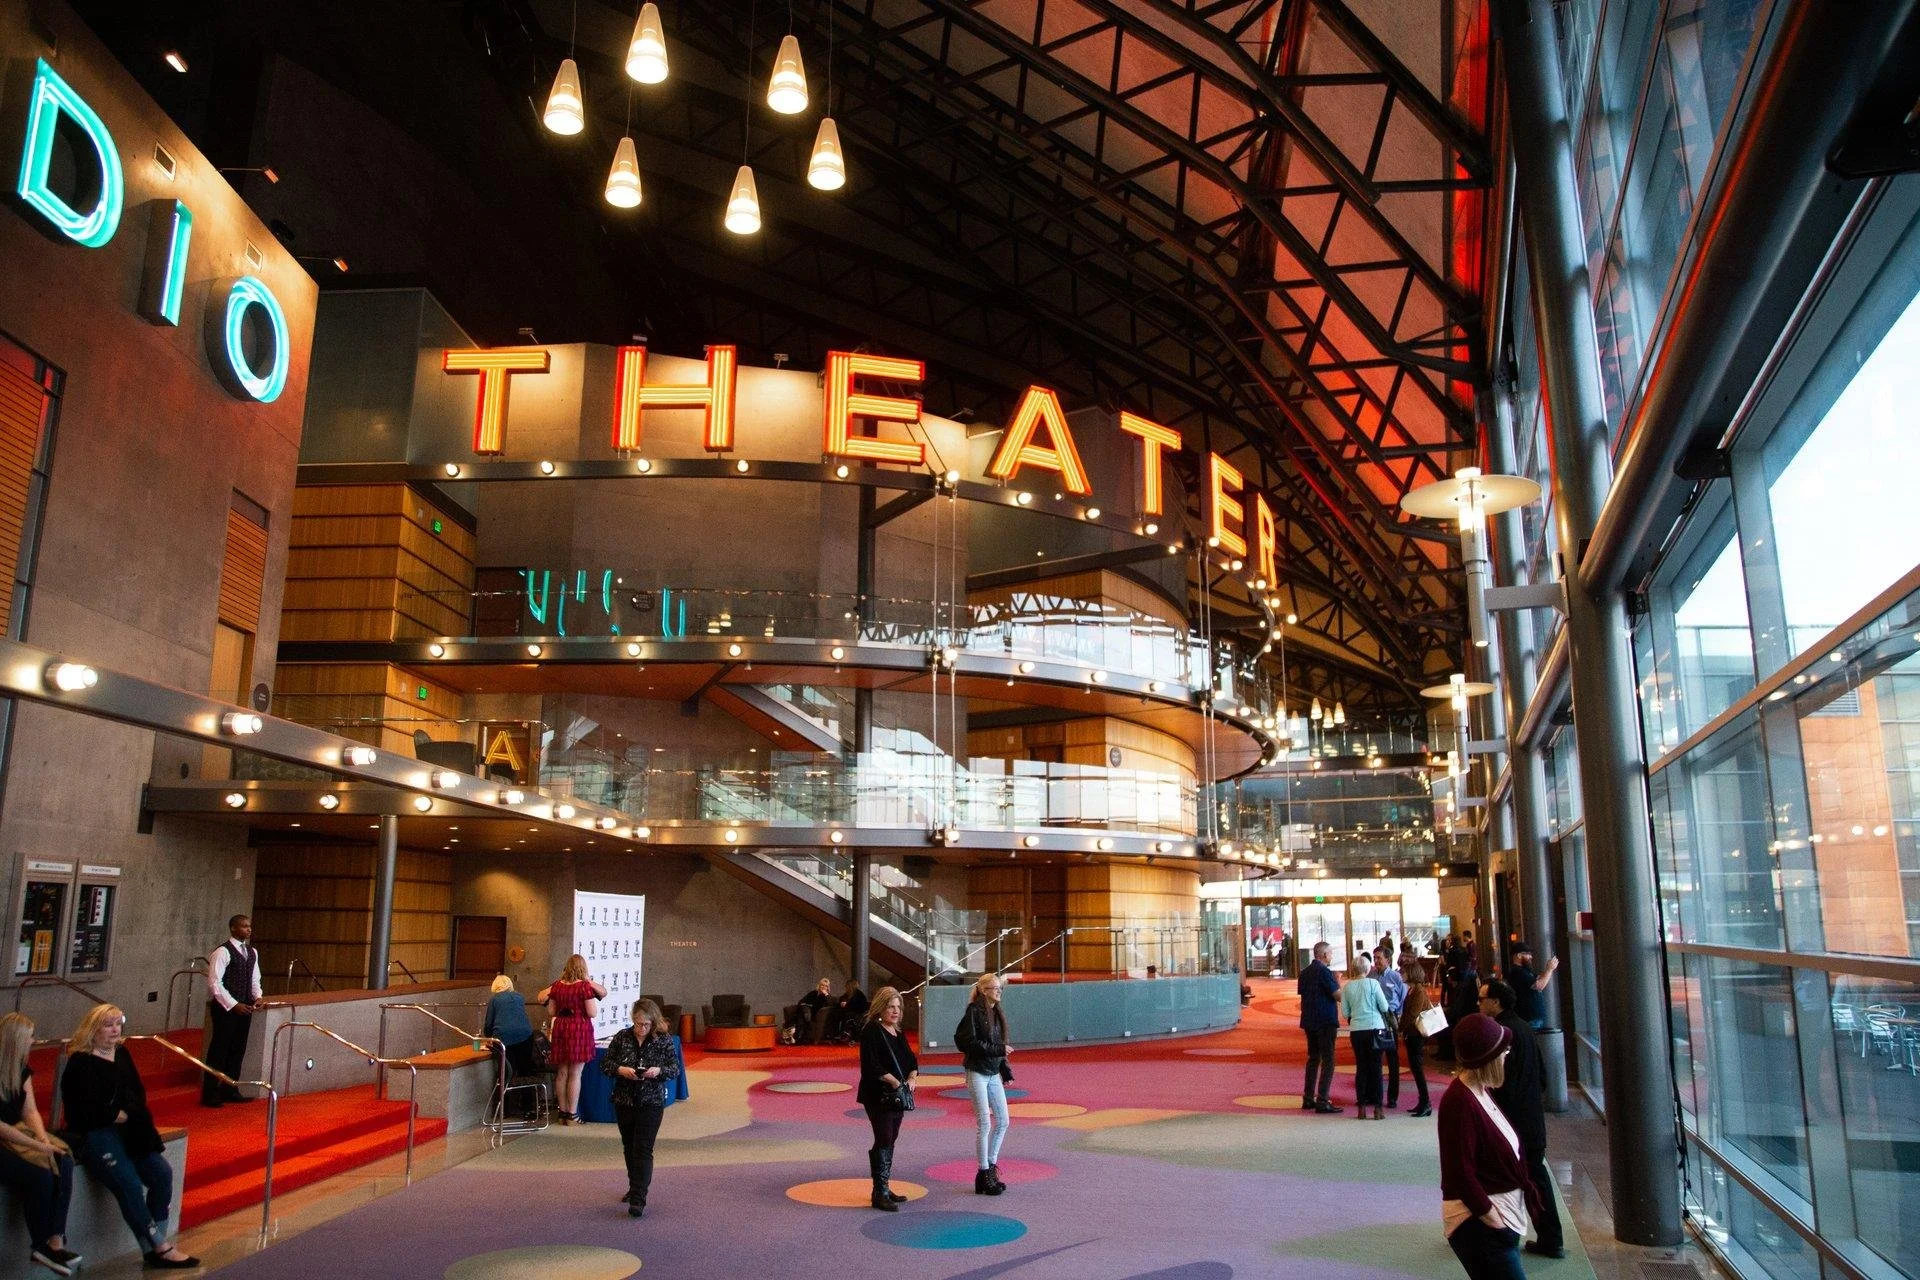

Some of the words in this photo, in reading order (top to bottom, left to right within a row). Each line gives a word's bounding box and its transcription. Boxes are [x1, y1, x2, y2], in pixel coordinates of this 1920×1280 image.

[18, 56, 290, 404] DIO
[441, 344, 1277, 589] THEATER
[484, 729, 521, 771] A
